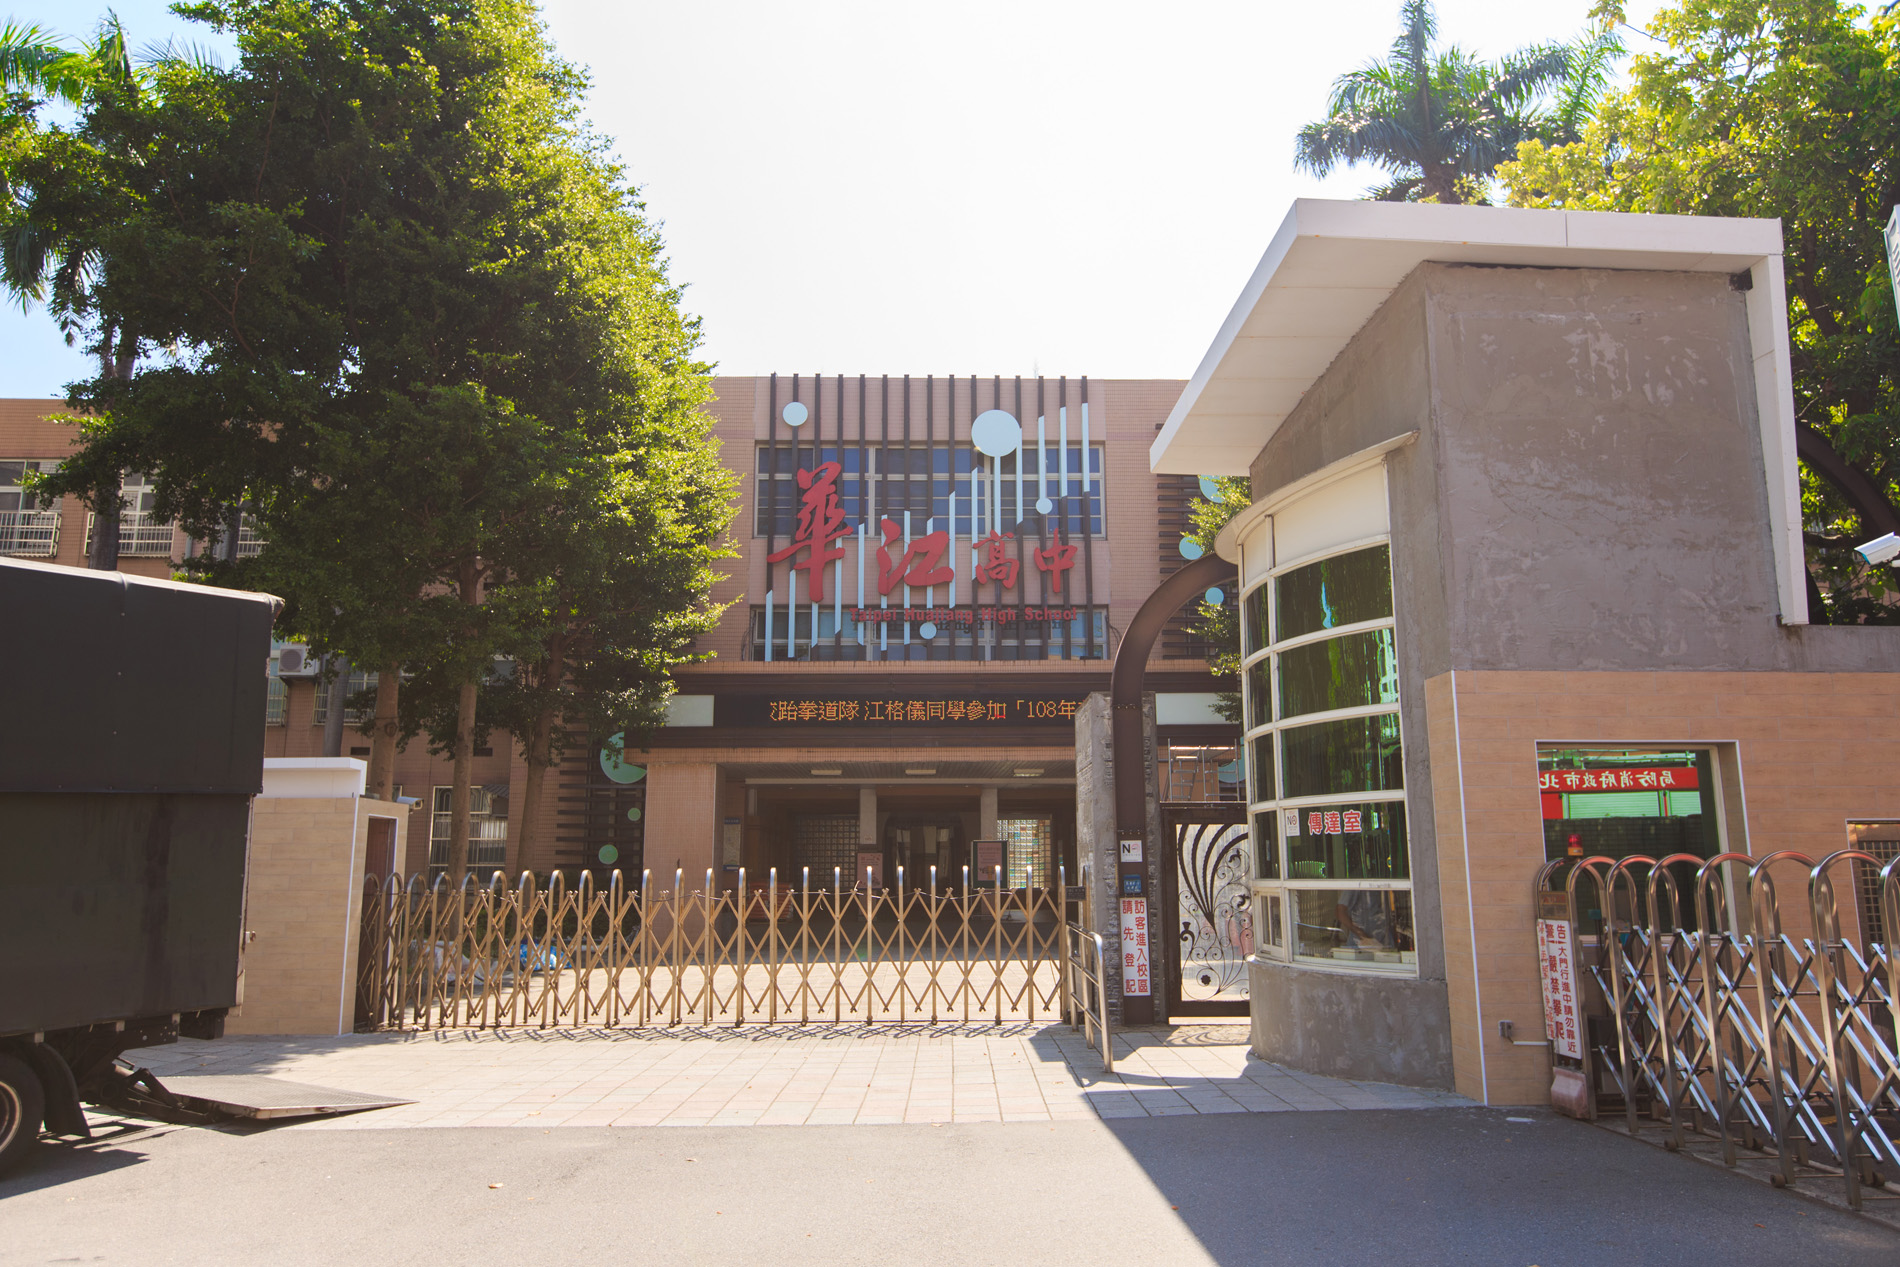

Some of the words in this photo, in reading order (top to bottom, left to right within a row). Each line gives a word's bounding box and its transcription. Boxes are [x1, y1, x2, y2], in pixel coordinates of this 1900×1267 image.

[766, 461, 1078, 602] 華江高中
[849, 608, 897, 624] Taipei
[905, 608, 973, 624] Huajiang
[982, 608, 1016, 624] High
[1025, 607, 1077, 620] School
[864, 700, 1086, 720] 江格儀同學參加「108年
[1308, 810, 1362, 836] 傳達室
[1122, 900, 1137, 993] 請先登記
[1134, 900, 1149, 993] 訪客進入校區
